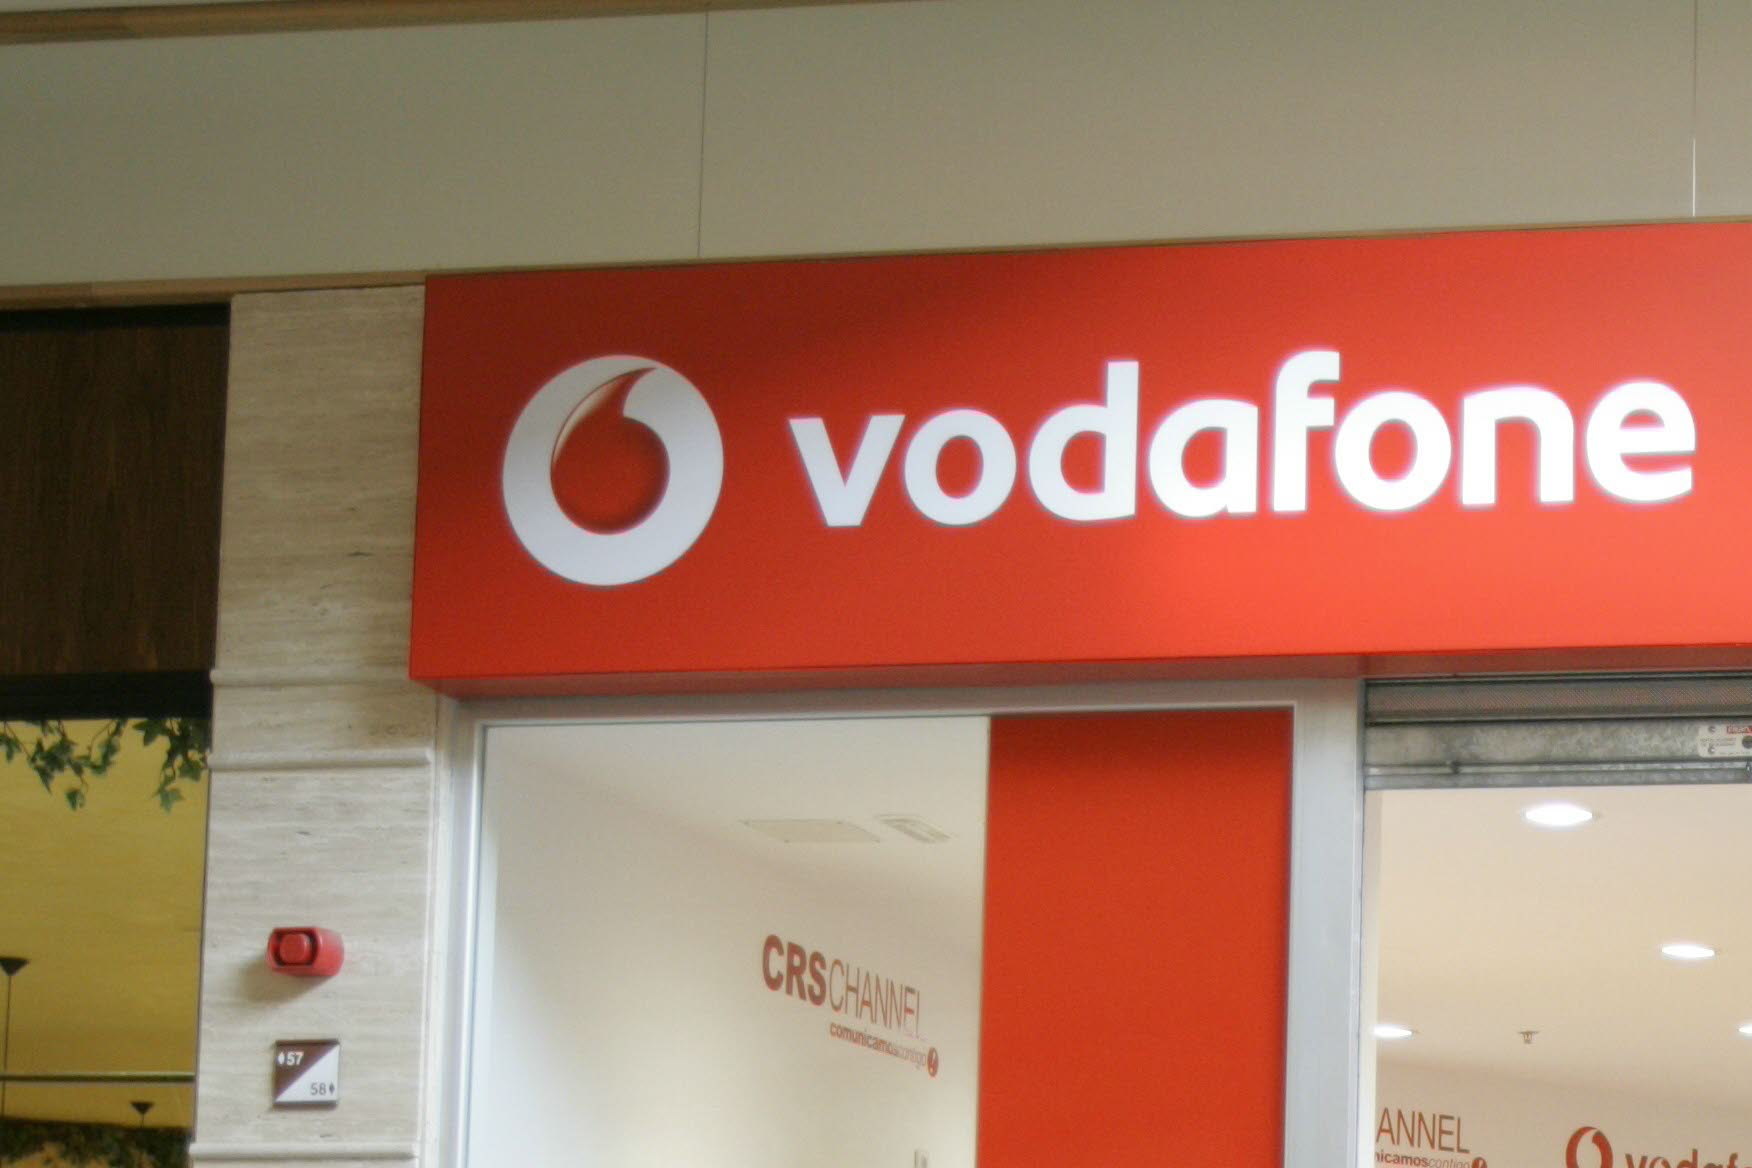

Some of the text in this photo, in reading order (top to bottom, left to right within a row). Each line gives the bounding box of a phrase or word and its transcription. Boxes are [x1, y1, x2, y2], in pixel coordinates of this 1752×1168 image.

[788, 349, 1697, 527] vodafone
[286, 1051, 305, 1067] 57
[310, 1081, 327, 1096] 58
